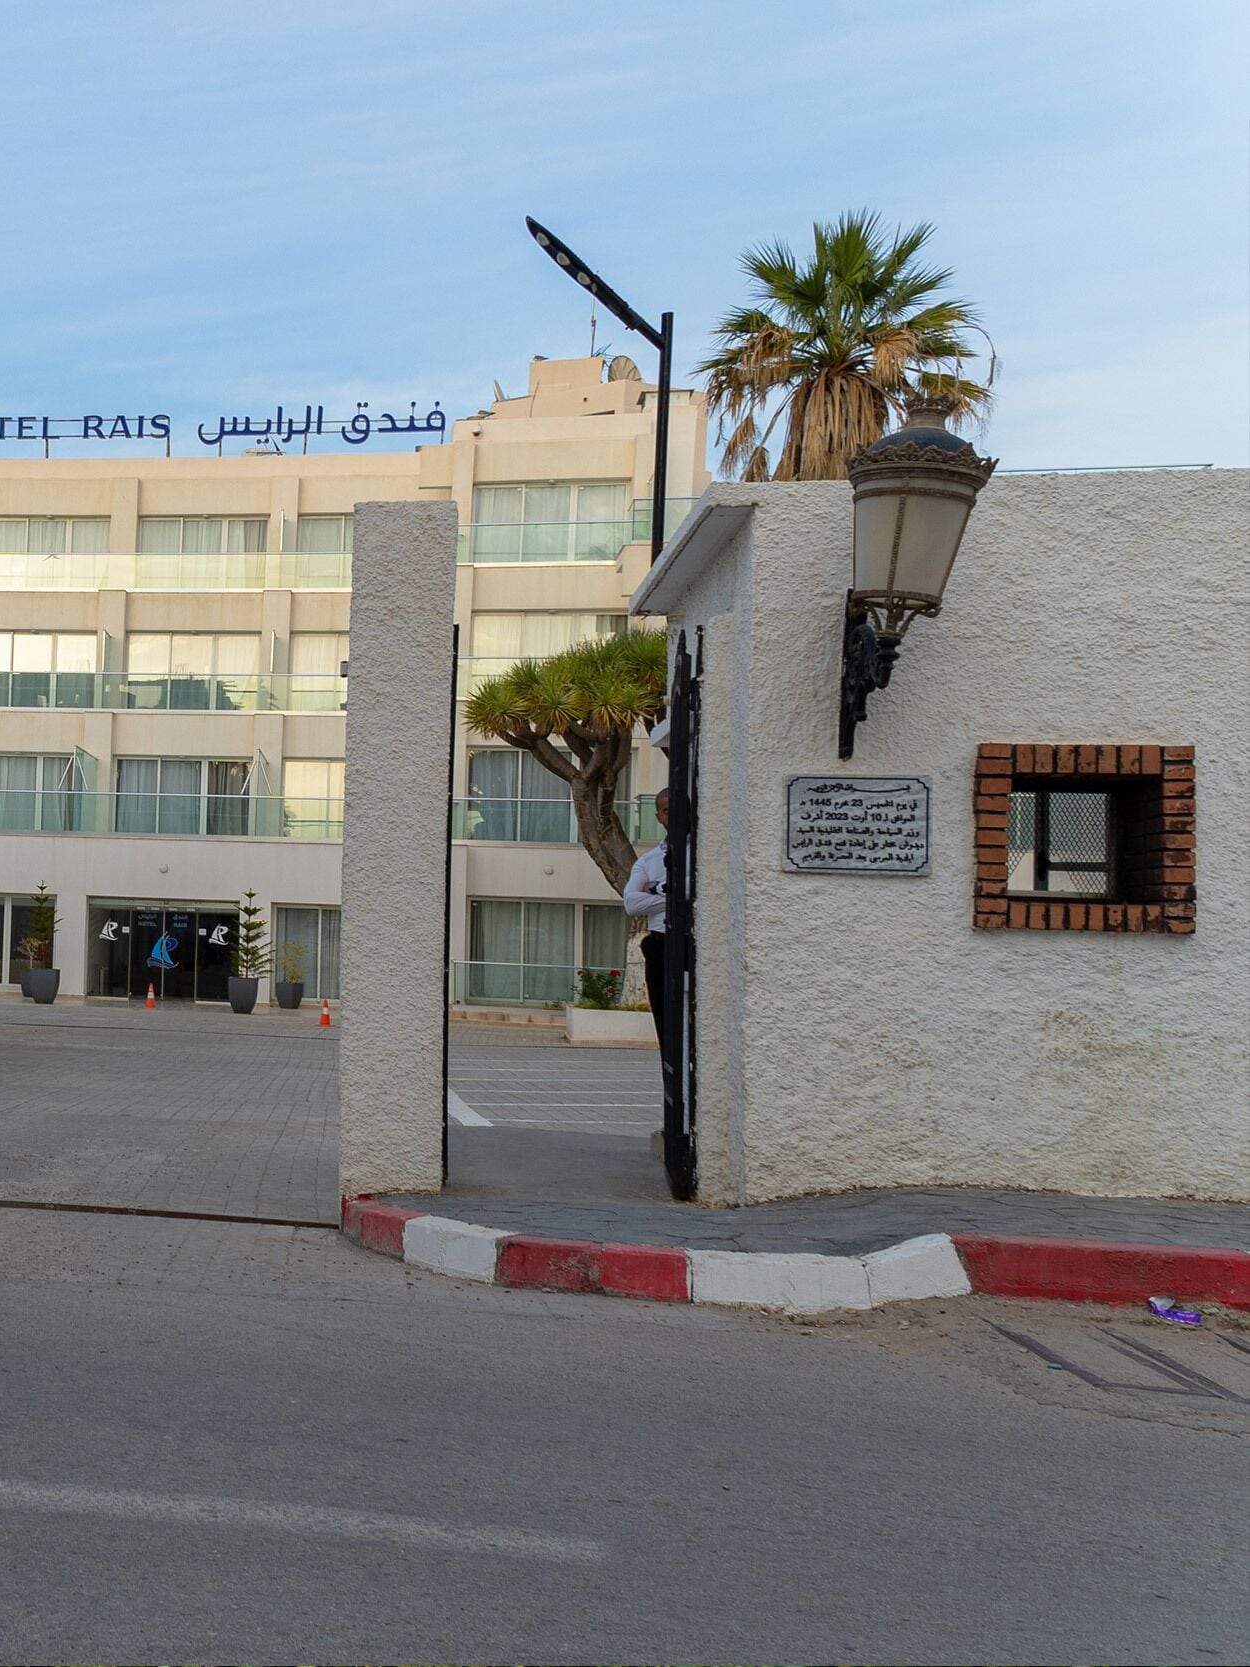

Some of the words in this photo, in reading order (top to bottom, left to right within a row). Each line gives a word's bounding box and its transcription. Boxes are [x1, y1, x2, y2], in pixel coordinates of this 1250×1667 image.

[81, 414, 171, 440] RAIS
[197, 405, 323, 445] الرايس
[340, 402, 446, 445] فندق
[810, 798, 832, 807] 1445
[850, 798, 864, 807] 23
[896, 803, 908, 812] يوم
[909, 799, 918, 812] في
[824, 812, 849, 821] 2023
[851, 810, 868, 823] أوت
[870, 813, 882, 821] 10
